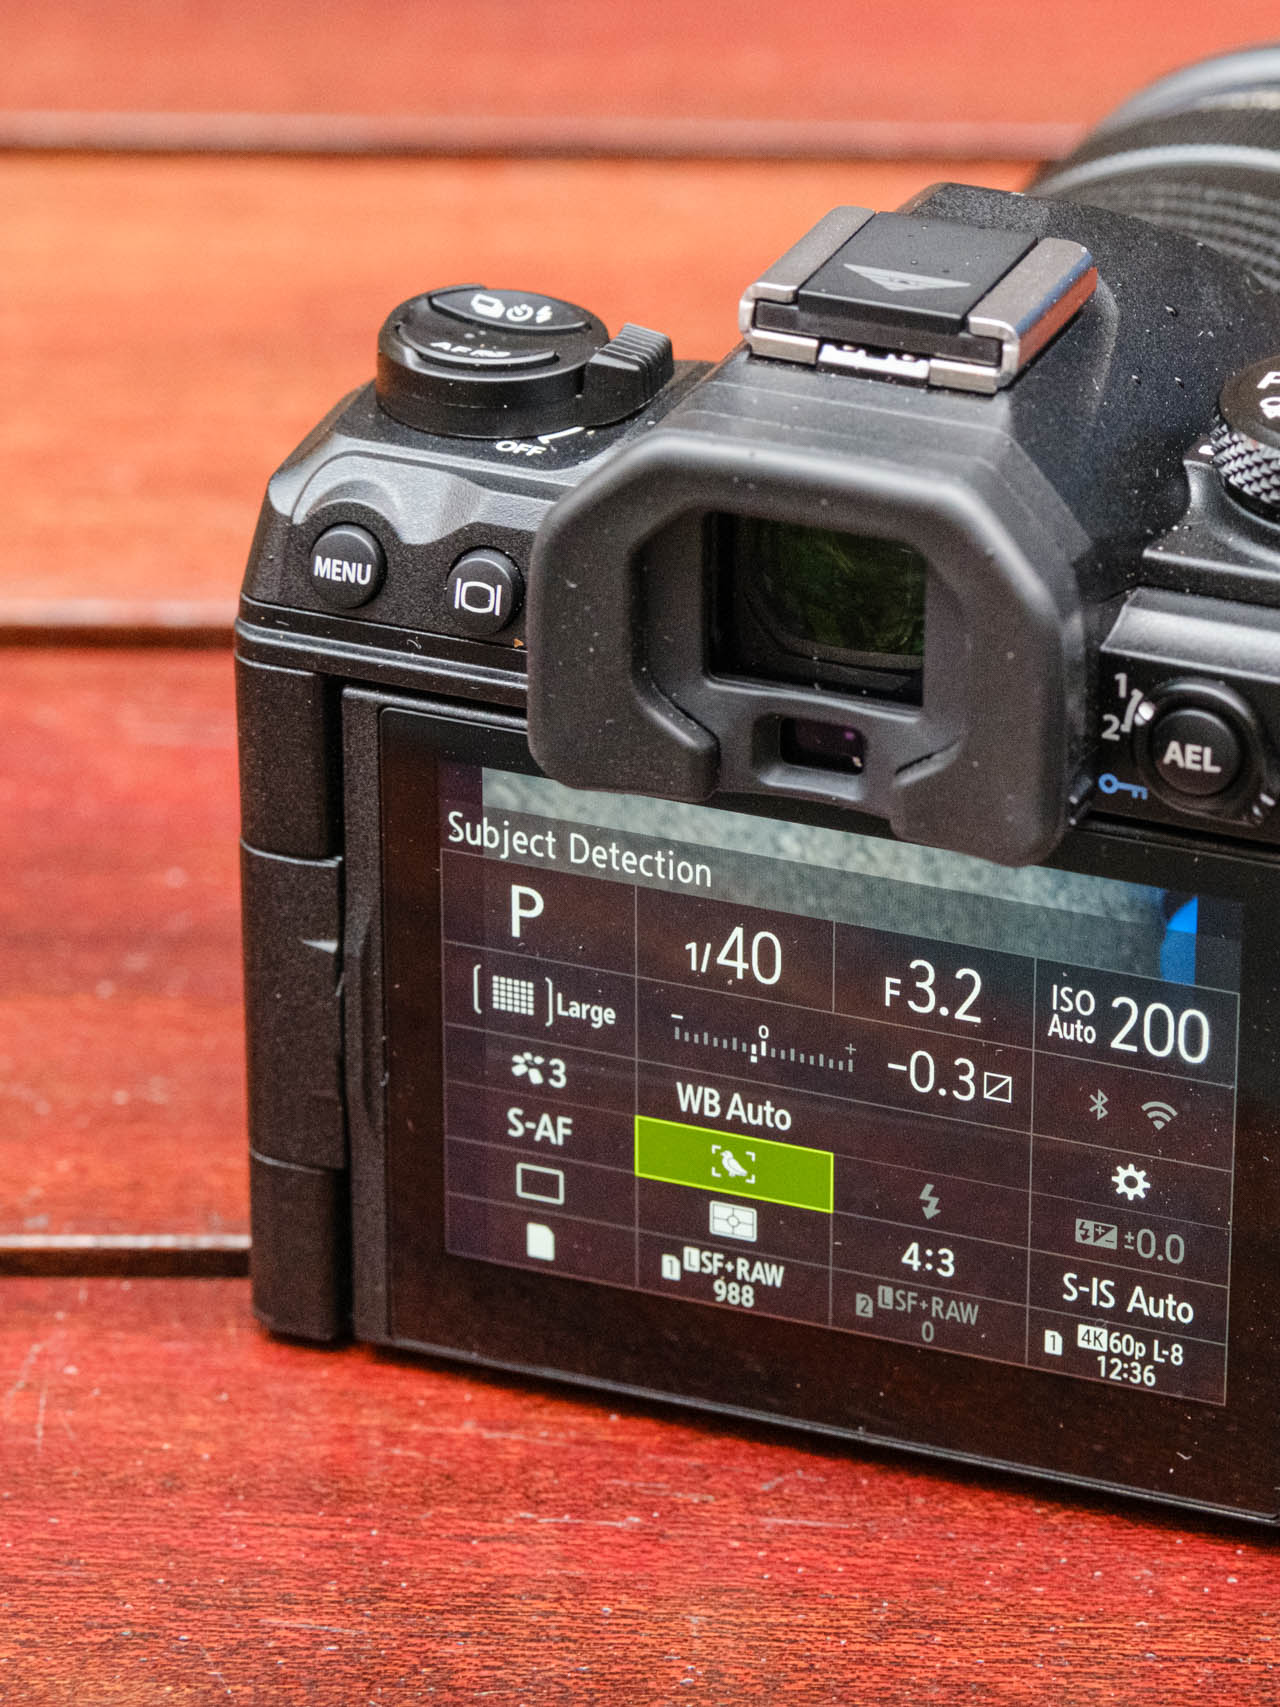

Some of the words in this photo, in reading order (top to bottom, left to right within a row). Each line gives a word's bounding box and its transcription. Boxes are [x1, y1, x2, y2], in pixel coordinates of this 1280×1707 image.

[495, 440, 547, 456] OFF
[313, 555, 372, 586] MENU
[1101, 714, 1121, 741] 2
[1162, 740, 1222, 774] AEL
[447, 810, 557, 860] Subject
[569, 832, 713, 888] Detection
[510, 884, 545, 938] P
[684, 926, 783, 986] 1/40
[884, 959, 982, 1024] F3.2
[1051, 984, 1096, 1016] ISO
[557, 992, 617, 1028] Large
[1047, 1013, 1097, 1045] Auto
[1110, 995, 1211, 1064] 200
[548, 1057, 568, 1089] 3
[676, 1082, 720, 1117] WB
[726, 1094, 792, 1131] Auto
[506, 1107, 573, 1146] S-AF
[901, 1242, 956, 1278] 4:3
[713, 1280, 755, 1308] 988
[1062, 1272, 1116, 1309] S-IS
[1126, 1286, 1195, 1325] Auto
[1153, 1338, 1184, 1366] L-8
[1097, 1354, 1157, 1387] 12:36
